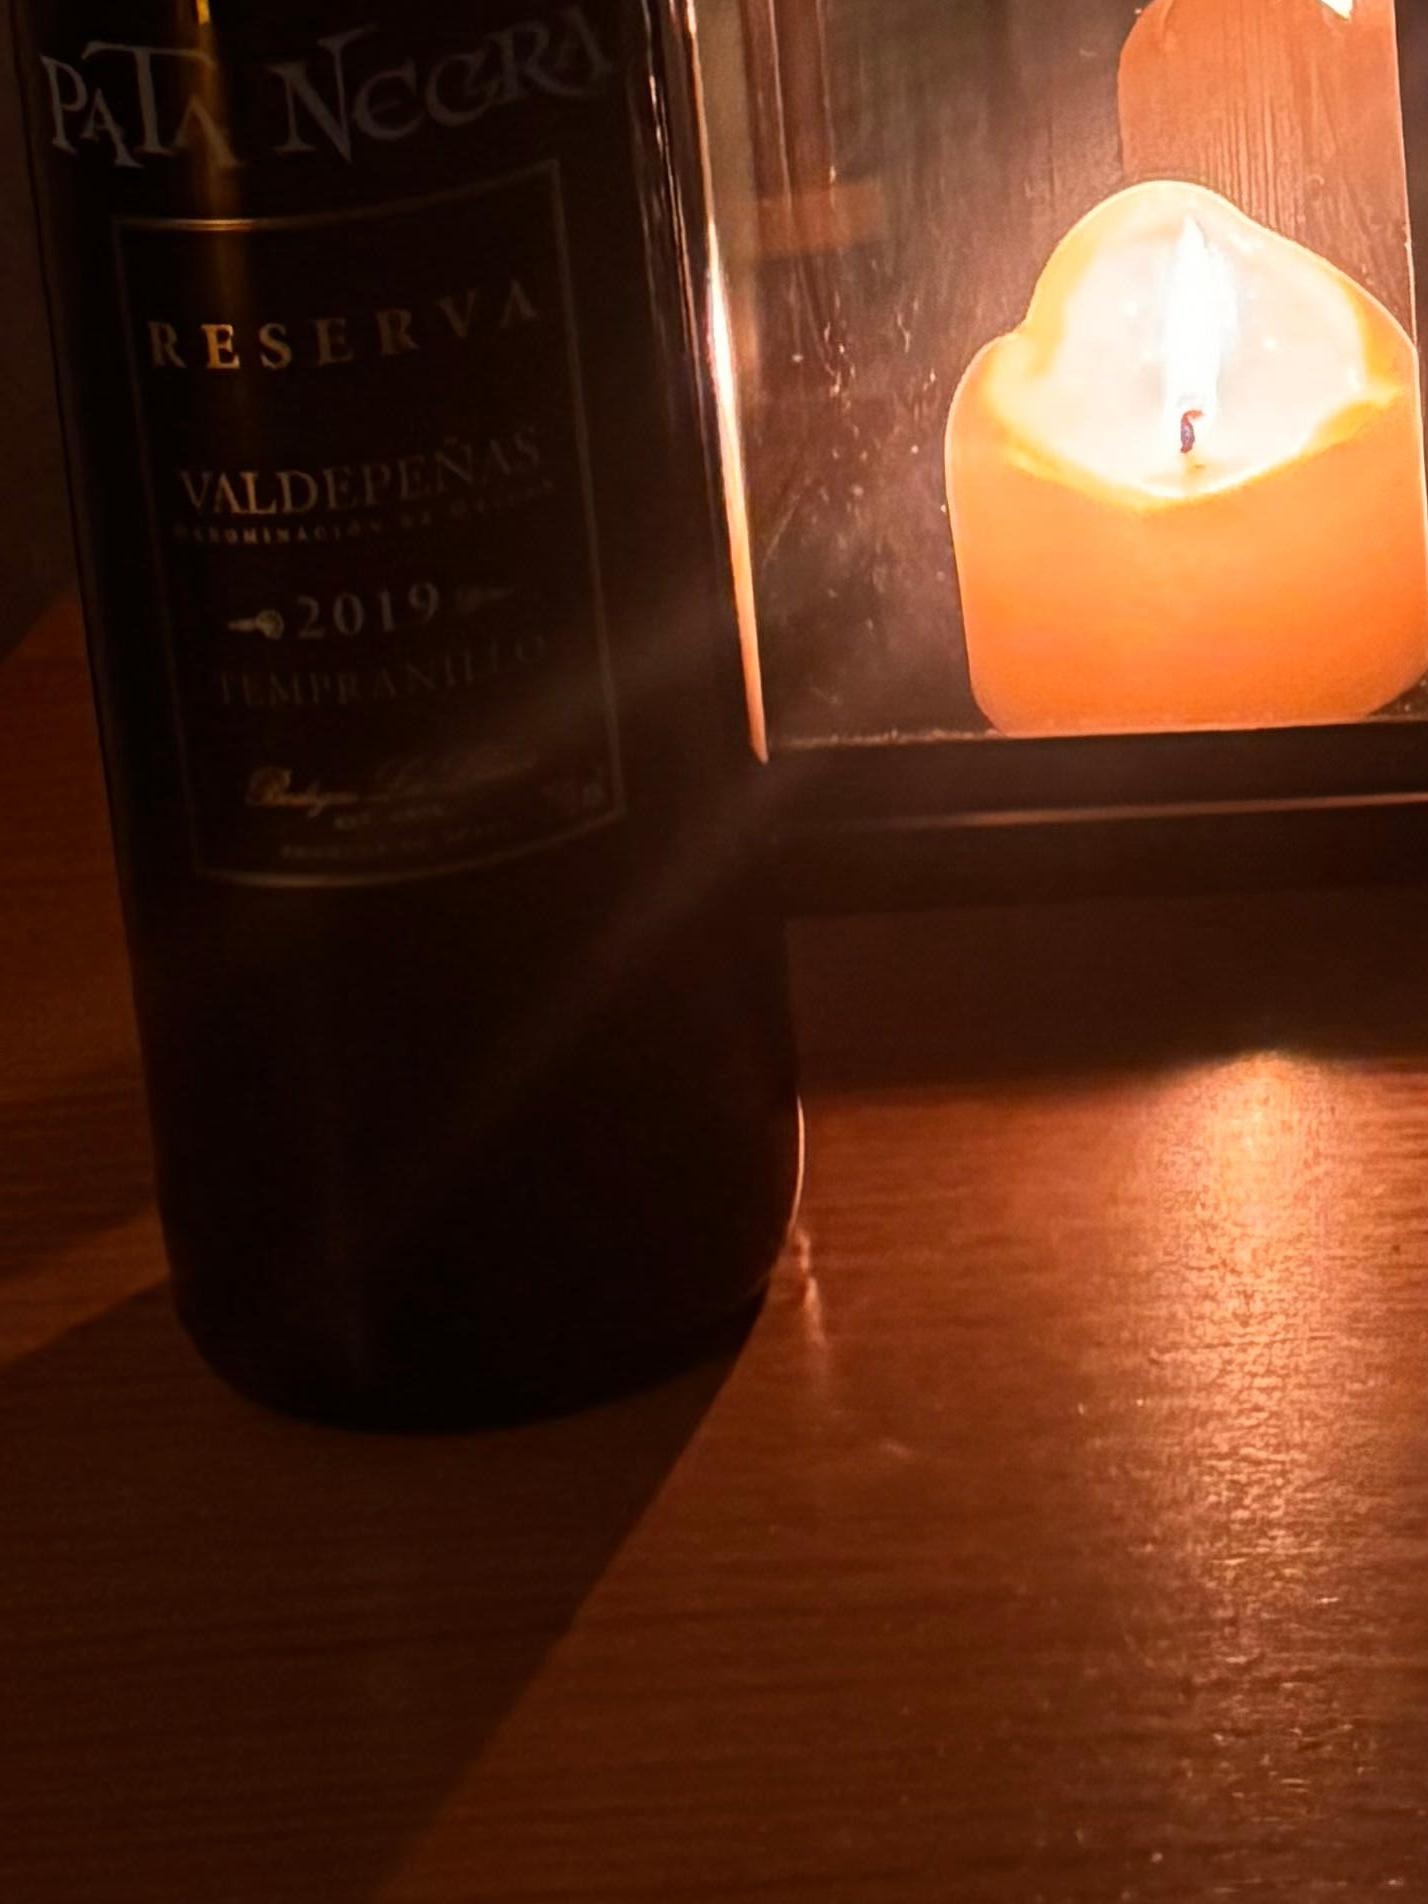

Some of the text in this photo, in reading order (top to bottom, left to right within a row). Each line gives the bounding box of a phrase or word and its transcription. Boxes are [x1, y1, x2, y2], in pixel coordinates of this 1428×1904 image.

[40, 40, 240, 169] PATA
[145, 278, 540, 373] RESERVA
[177, 424, 546, 517] VALDEPEÑAS
[296, 581, 440, 640] 2019
[212, 634, 547, 709] TEMPRANILLO
